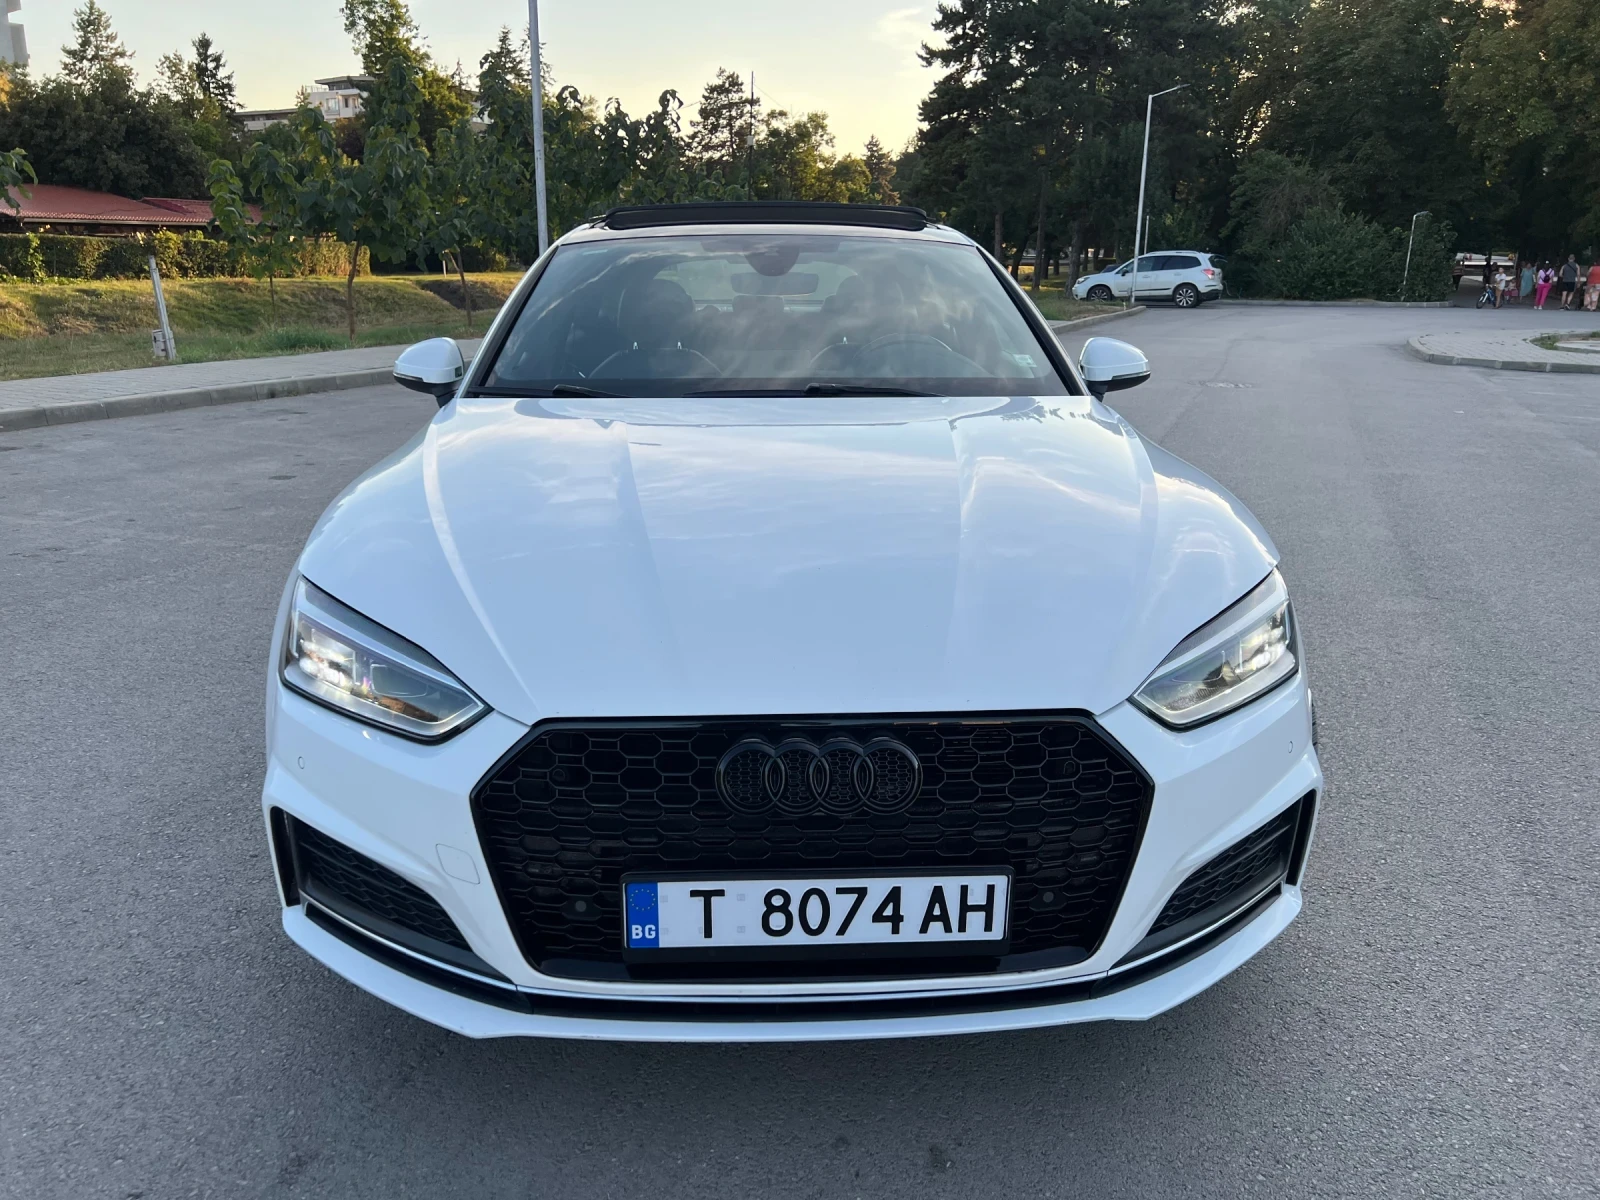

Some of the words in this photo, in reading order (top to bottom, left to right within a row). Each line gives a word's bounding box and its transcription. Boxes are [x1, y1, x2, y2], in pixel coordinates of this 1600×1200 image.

[690, 889, 726, 939] T
[761, 886, 904, 937] 8074
[918, 884, 996, 935] AH
[631, 924, 657, 940] BG
